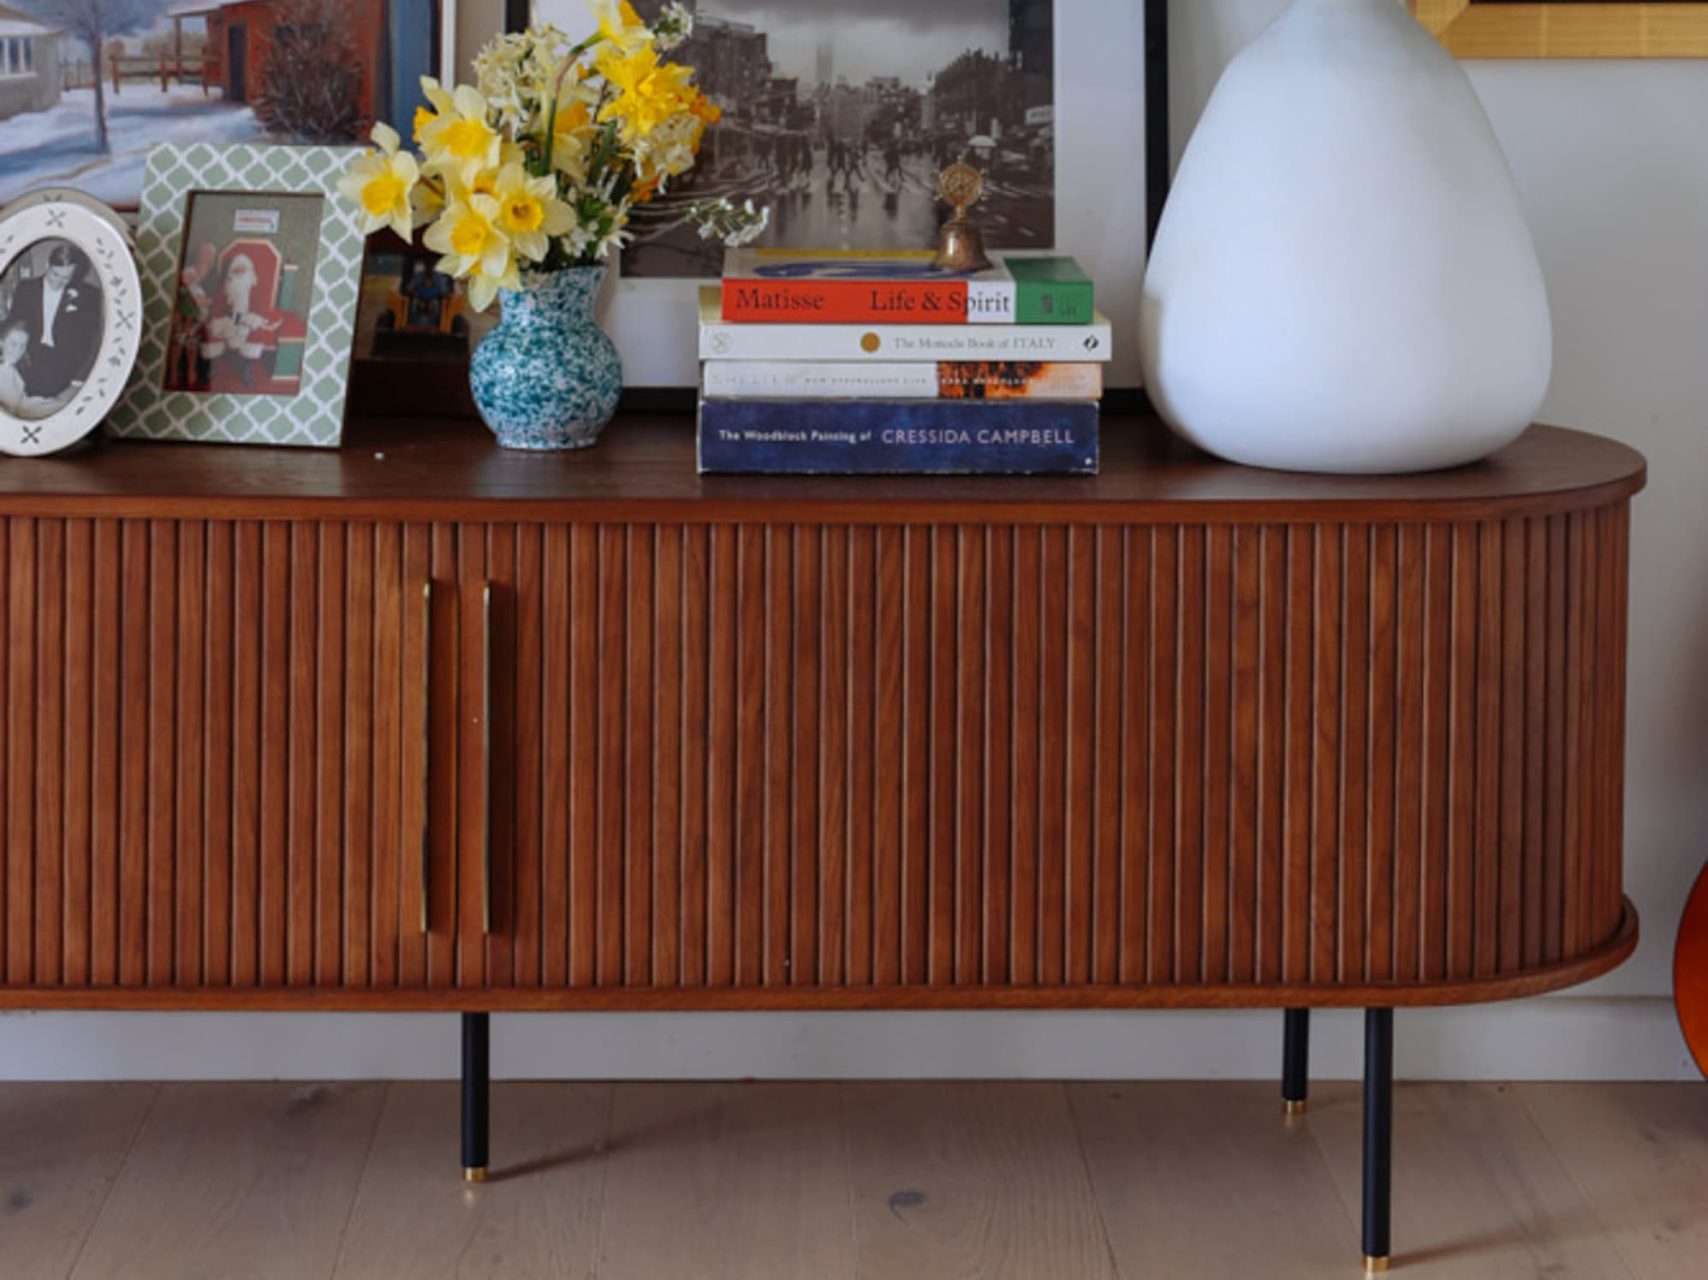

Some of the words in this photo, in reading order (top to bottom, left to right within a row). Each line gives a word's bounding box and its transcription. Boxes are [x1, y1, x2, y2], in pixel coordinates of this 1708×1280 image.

[735, 287, 825, 312] Matisse
[869, 288, 916, 312] Life
[920, 290, 942, 312] &
[946, 289, 1011, 316] Spirit
[893, 336, 915, 350] The
[967, 336, 995, 350] Book
[998, 336, 1010, 350] of
[1012, 336, 1057, 350] ITALY
[718, 429, 740, 442] The
[743, 429, 808, 442] Woodblock
[811, 429, 857, 445] Painting
[859, 429, 873, 442] of
[880, 428, 972, 445] CRESSIDA
[976, 428, 1076, 445] CAMPBELL
